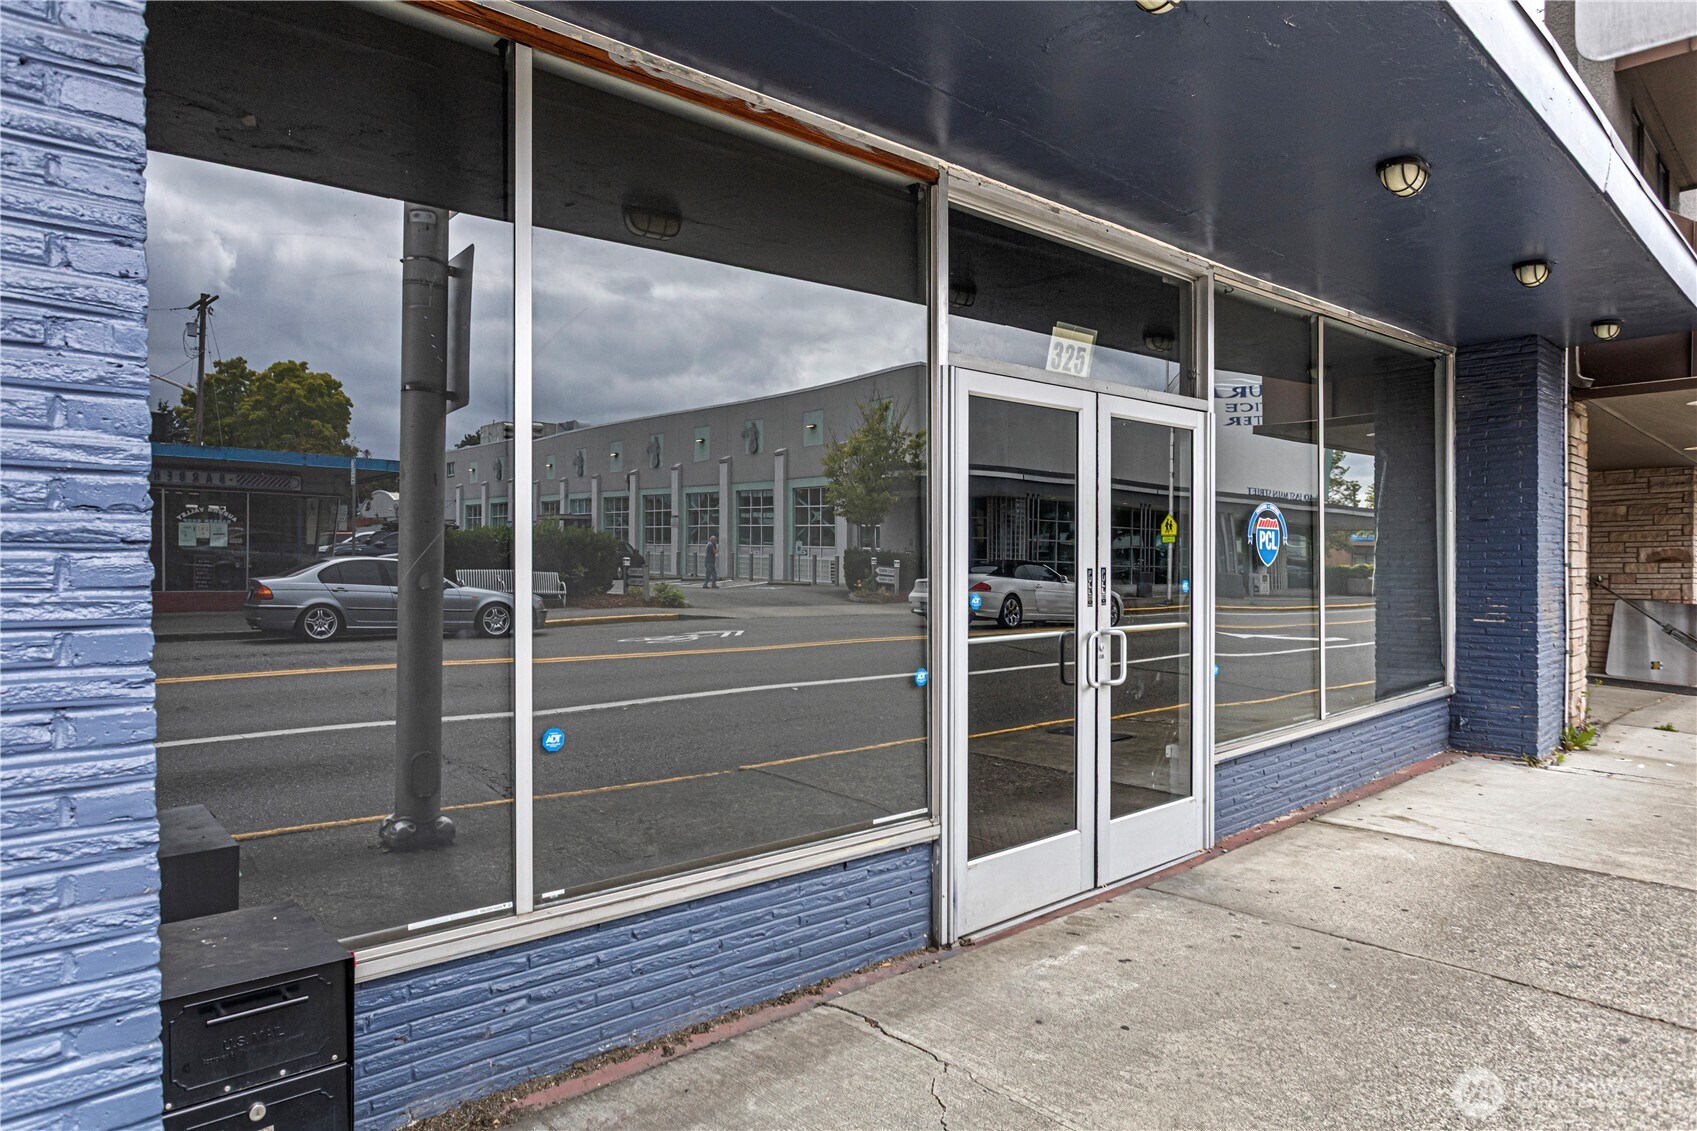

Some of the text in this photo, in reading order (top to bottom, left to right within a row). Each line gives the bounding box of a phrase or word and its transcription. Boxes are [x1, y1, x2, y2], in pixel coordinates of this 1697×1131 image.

[1051, 341, 1087, 375] 325
[1259, 530, 1278, 550] PCL
[545, 734, 562, 743] ADT
